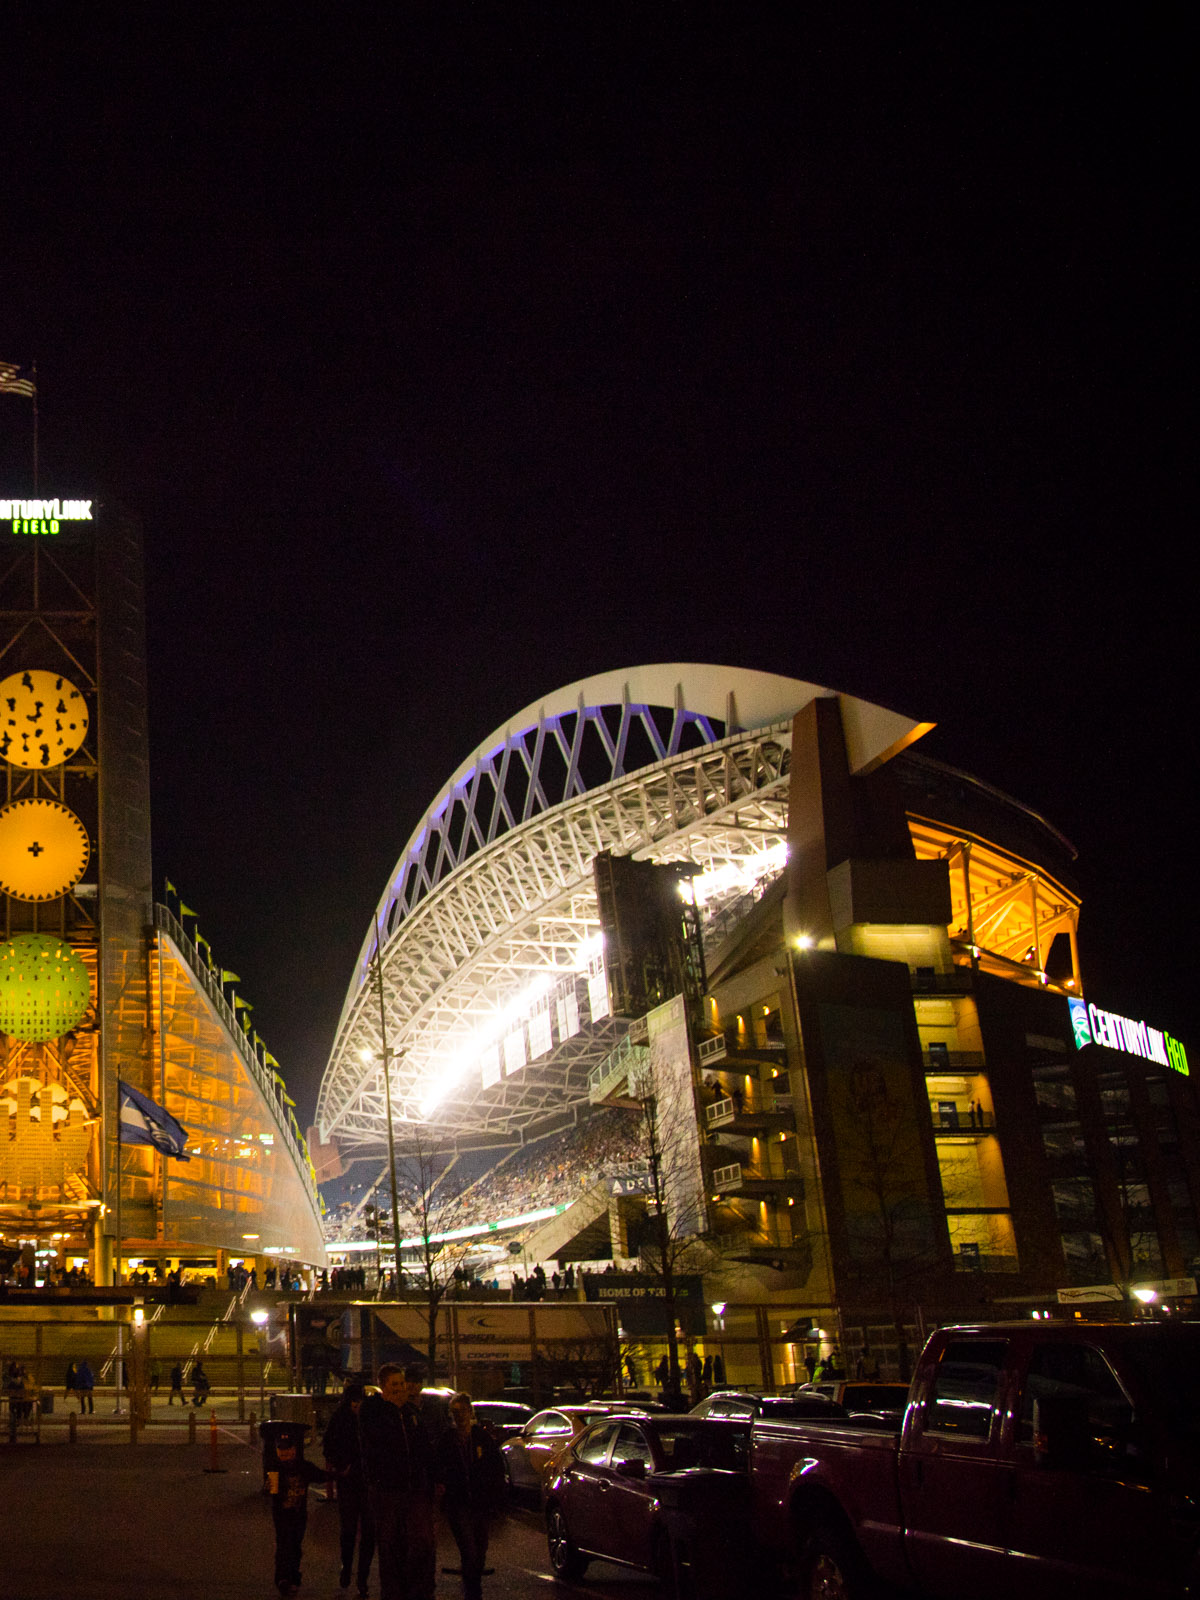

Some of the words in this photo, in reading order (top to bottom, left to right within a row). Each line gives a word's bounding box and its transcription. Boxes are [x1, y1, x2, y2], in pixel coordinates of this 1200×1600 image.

[13, 520, 60, 534] FIELD
[1164, 1031, 1190, 1077] FIELD
[599, 1287, 632, 1297] HOME
